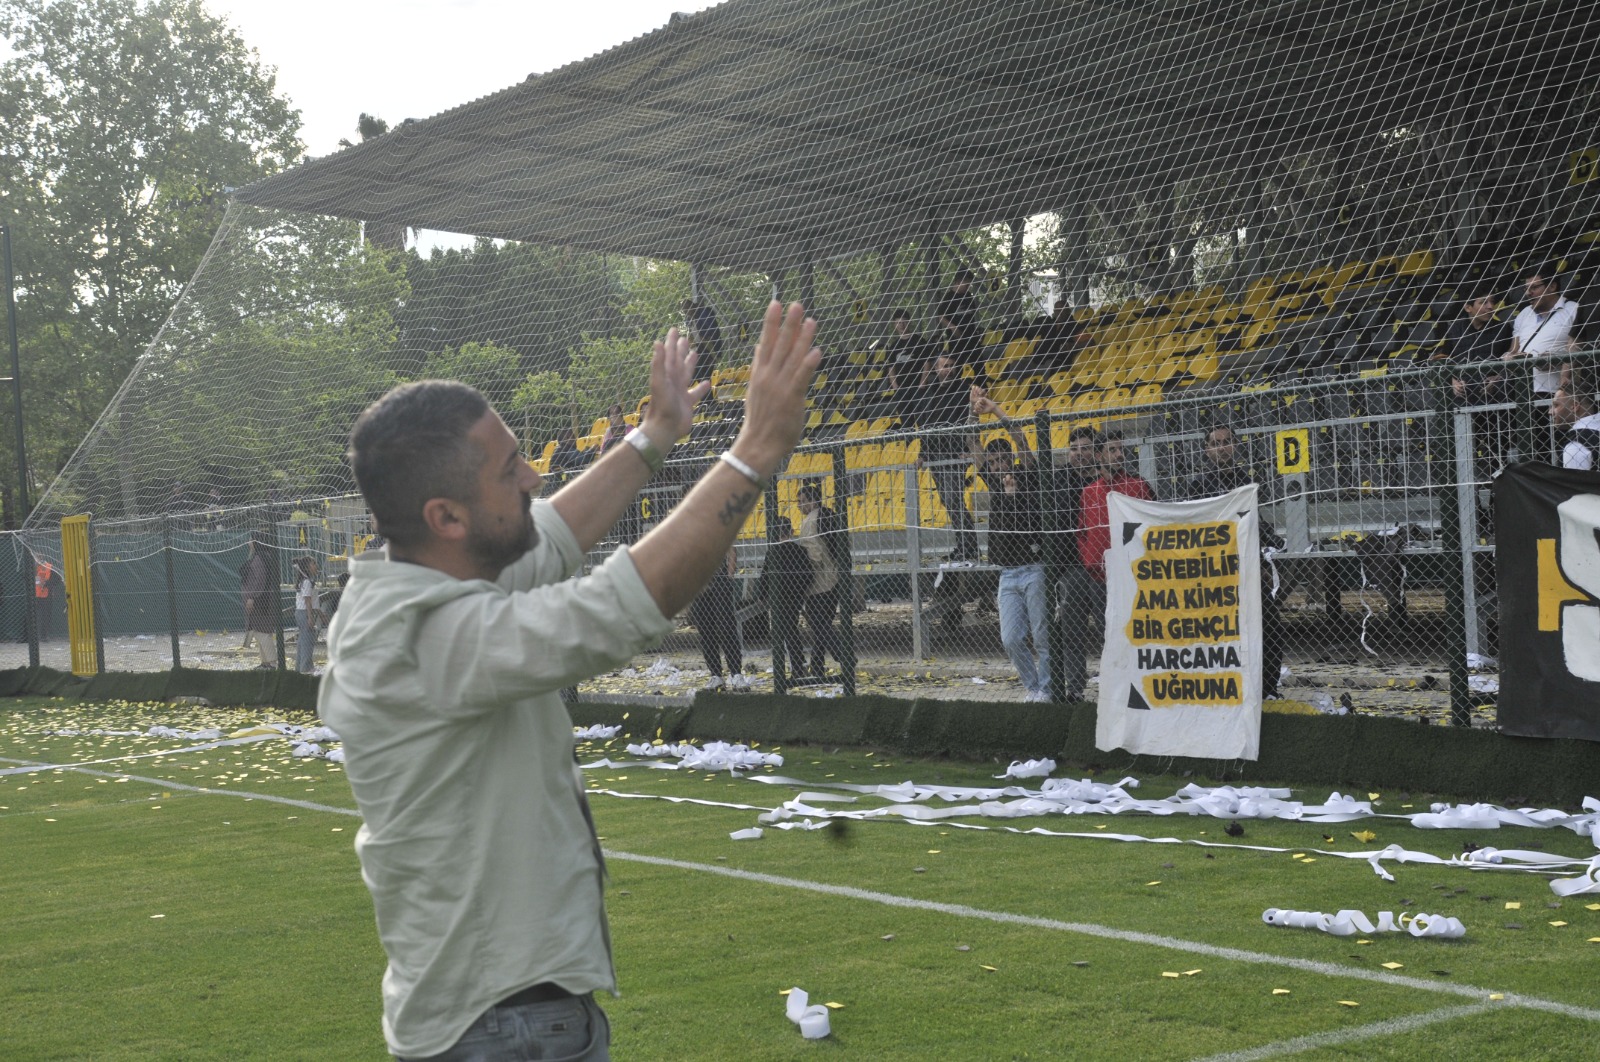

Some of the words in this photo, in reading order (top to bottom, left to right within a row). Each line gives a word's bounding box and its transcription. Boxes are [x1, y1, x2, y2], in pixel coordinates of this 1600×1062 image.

[1576, 156, 1591, 178] D
[1283, 437, 1300, 466] D
[641, 498, 651, 519] C
[1147, 525, 1231, 550] HERKES
[1136, 589, 1179, 610] AMA
[1133, 614, 1164, 639] BİR
[1138, 647, 1242, 669] HARCAMA
[1152, 673, 1238, 700] UĞRUNA
